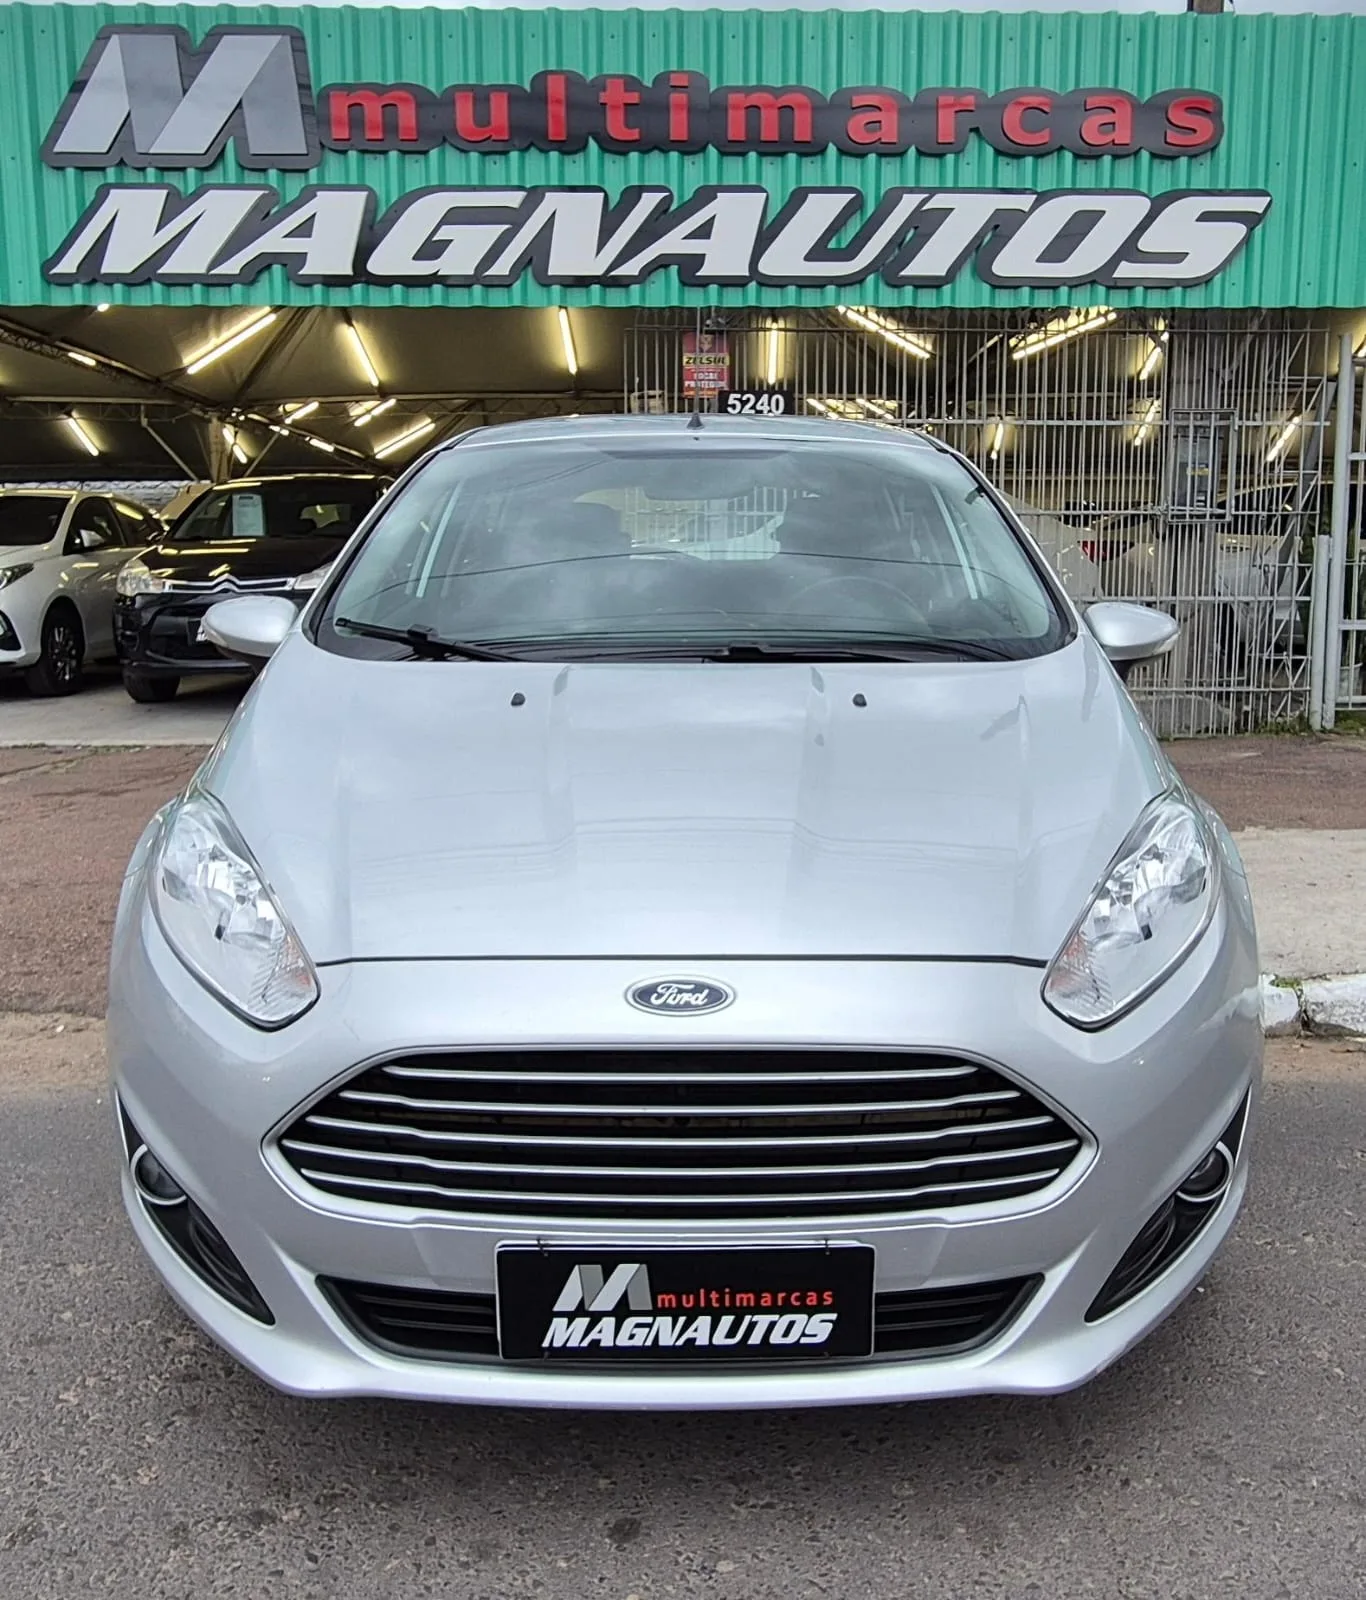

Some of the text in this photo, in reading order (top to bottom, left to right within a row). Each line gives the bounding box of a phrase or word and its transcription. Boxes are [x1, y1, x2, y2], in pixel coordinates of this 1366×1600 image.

[54, 34, 1220, 155] M multimarcas
[49, 188, 1272, 279] MAGNAUTOS
[727, 393, 785, 415] 5240
[650, 983, 710, 1006] Ford
[552, 1263, 834, 1312] M multimarcas
[541, 1313, 838, 1348] MAGNAUTOS
